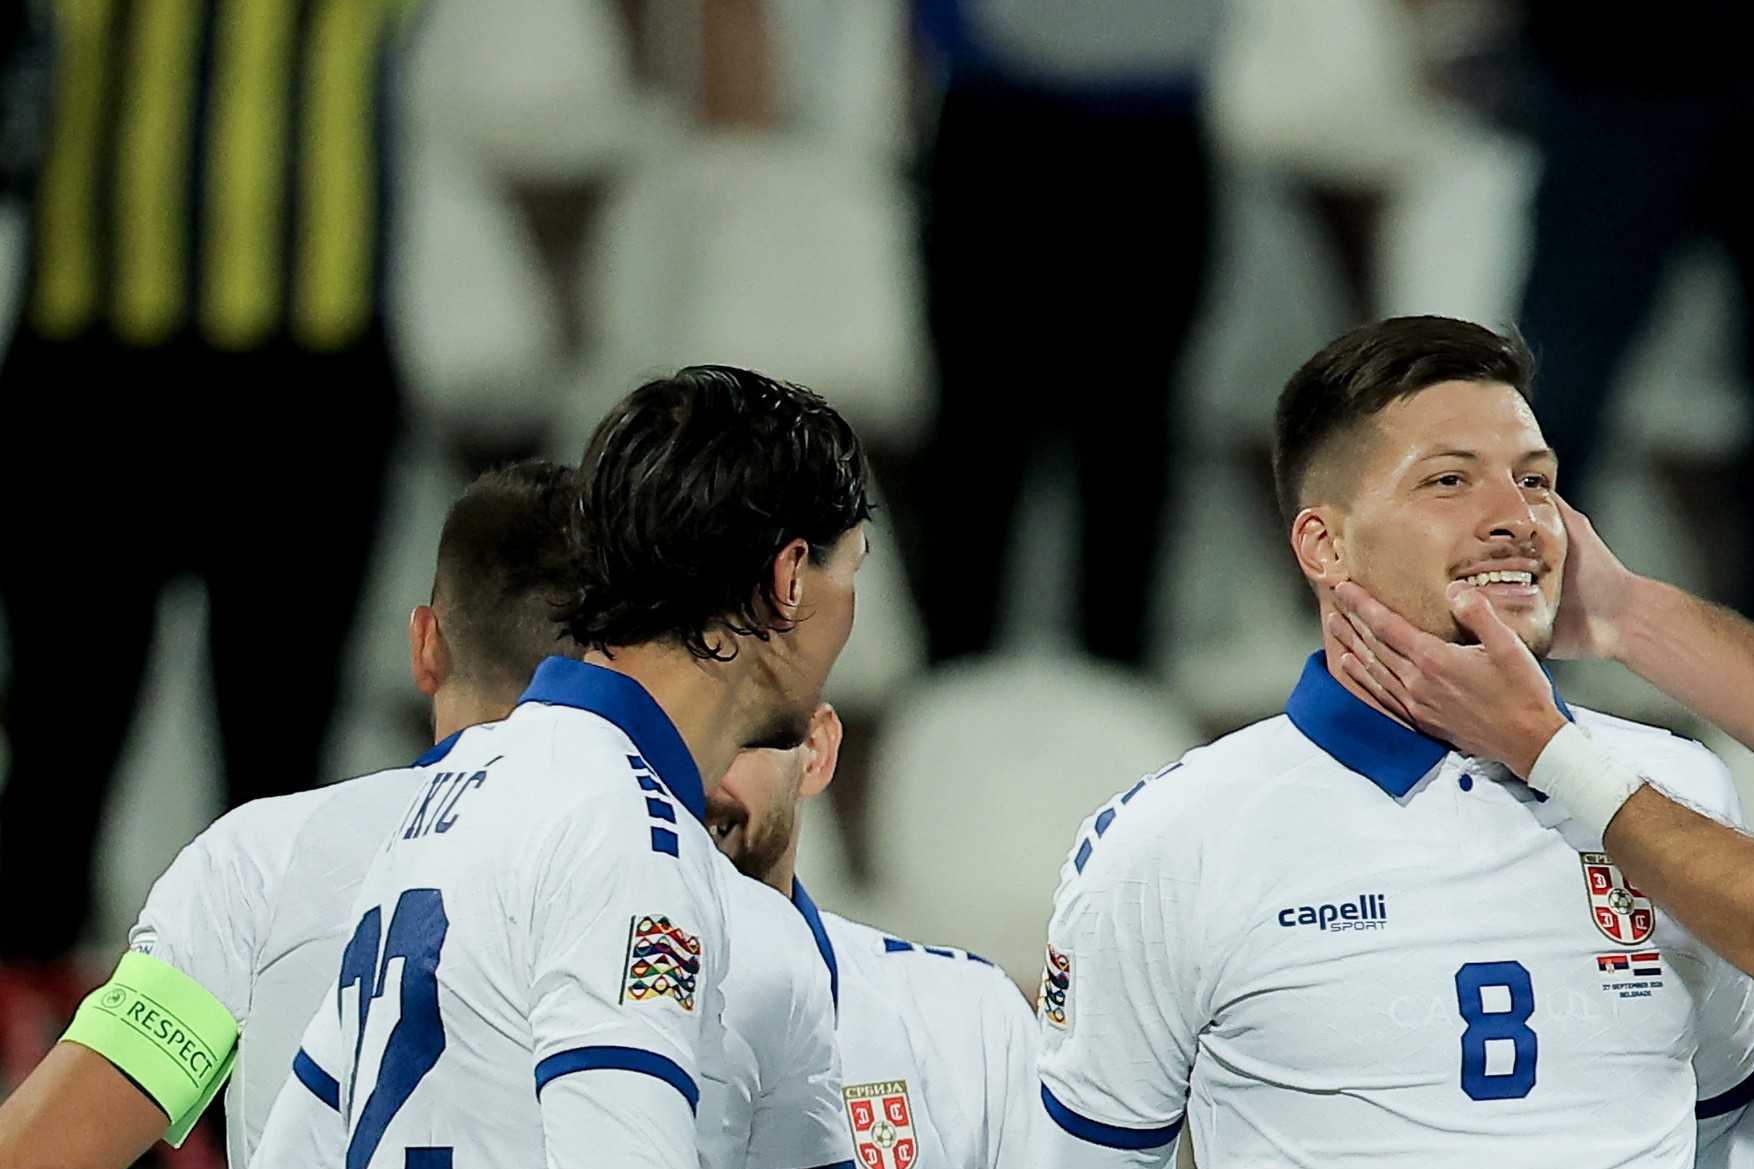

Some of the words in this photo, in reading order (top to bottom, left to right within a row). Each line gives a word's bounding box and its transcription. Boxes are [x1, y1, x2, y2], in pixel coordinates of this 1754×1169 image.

[1278, 894, 1387, 931] capelli
[1330, 920, 1387, 932] SPORT
[126, 1000, 213, 1079] RESPECT
[1454, 960, 1538, 1101] 8
[844, 1081, 904, 1099] СРБИЈА
